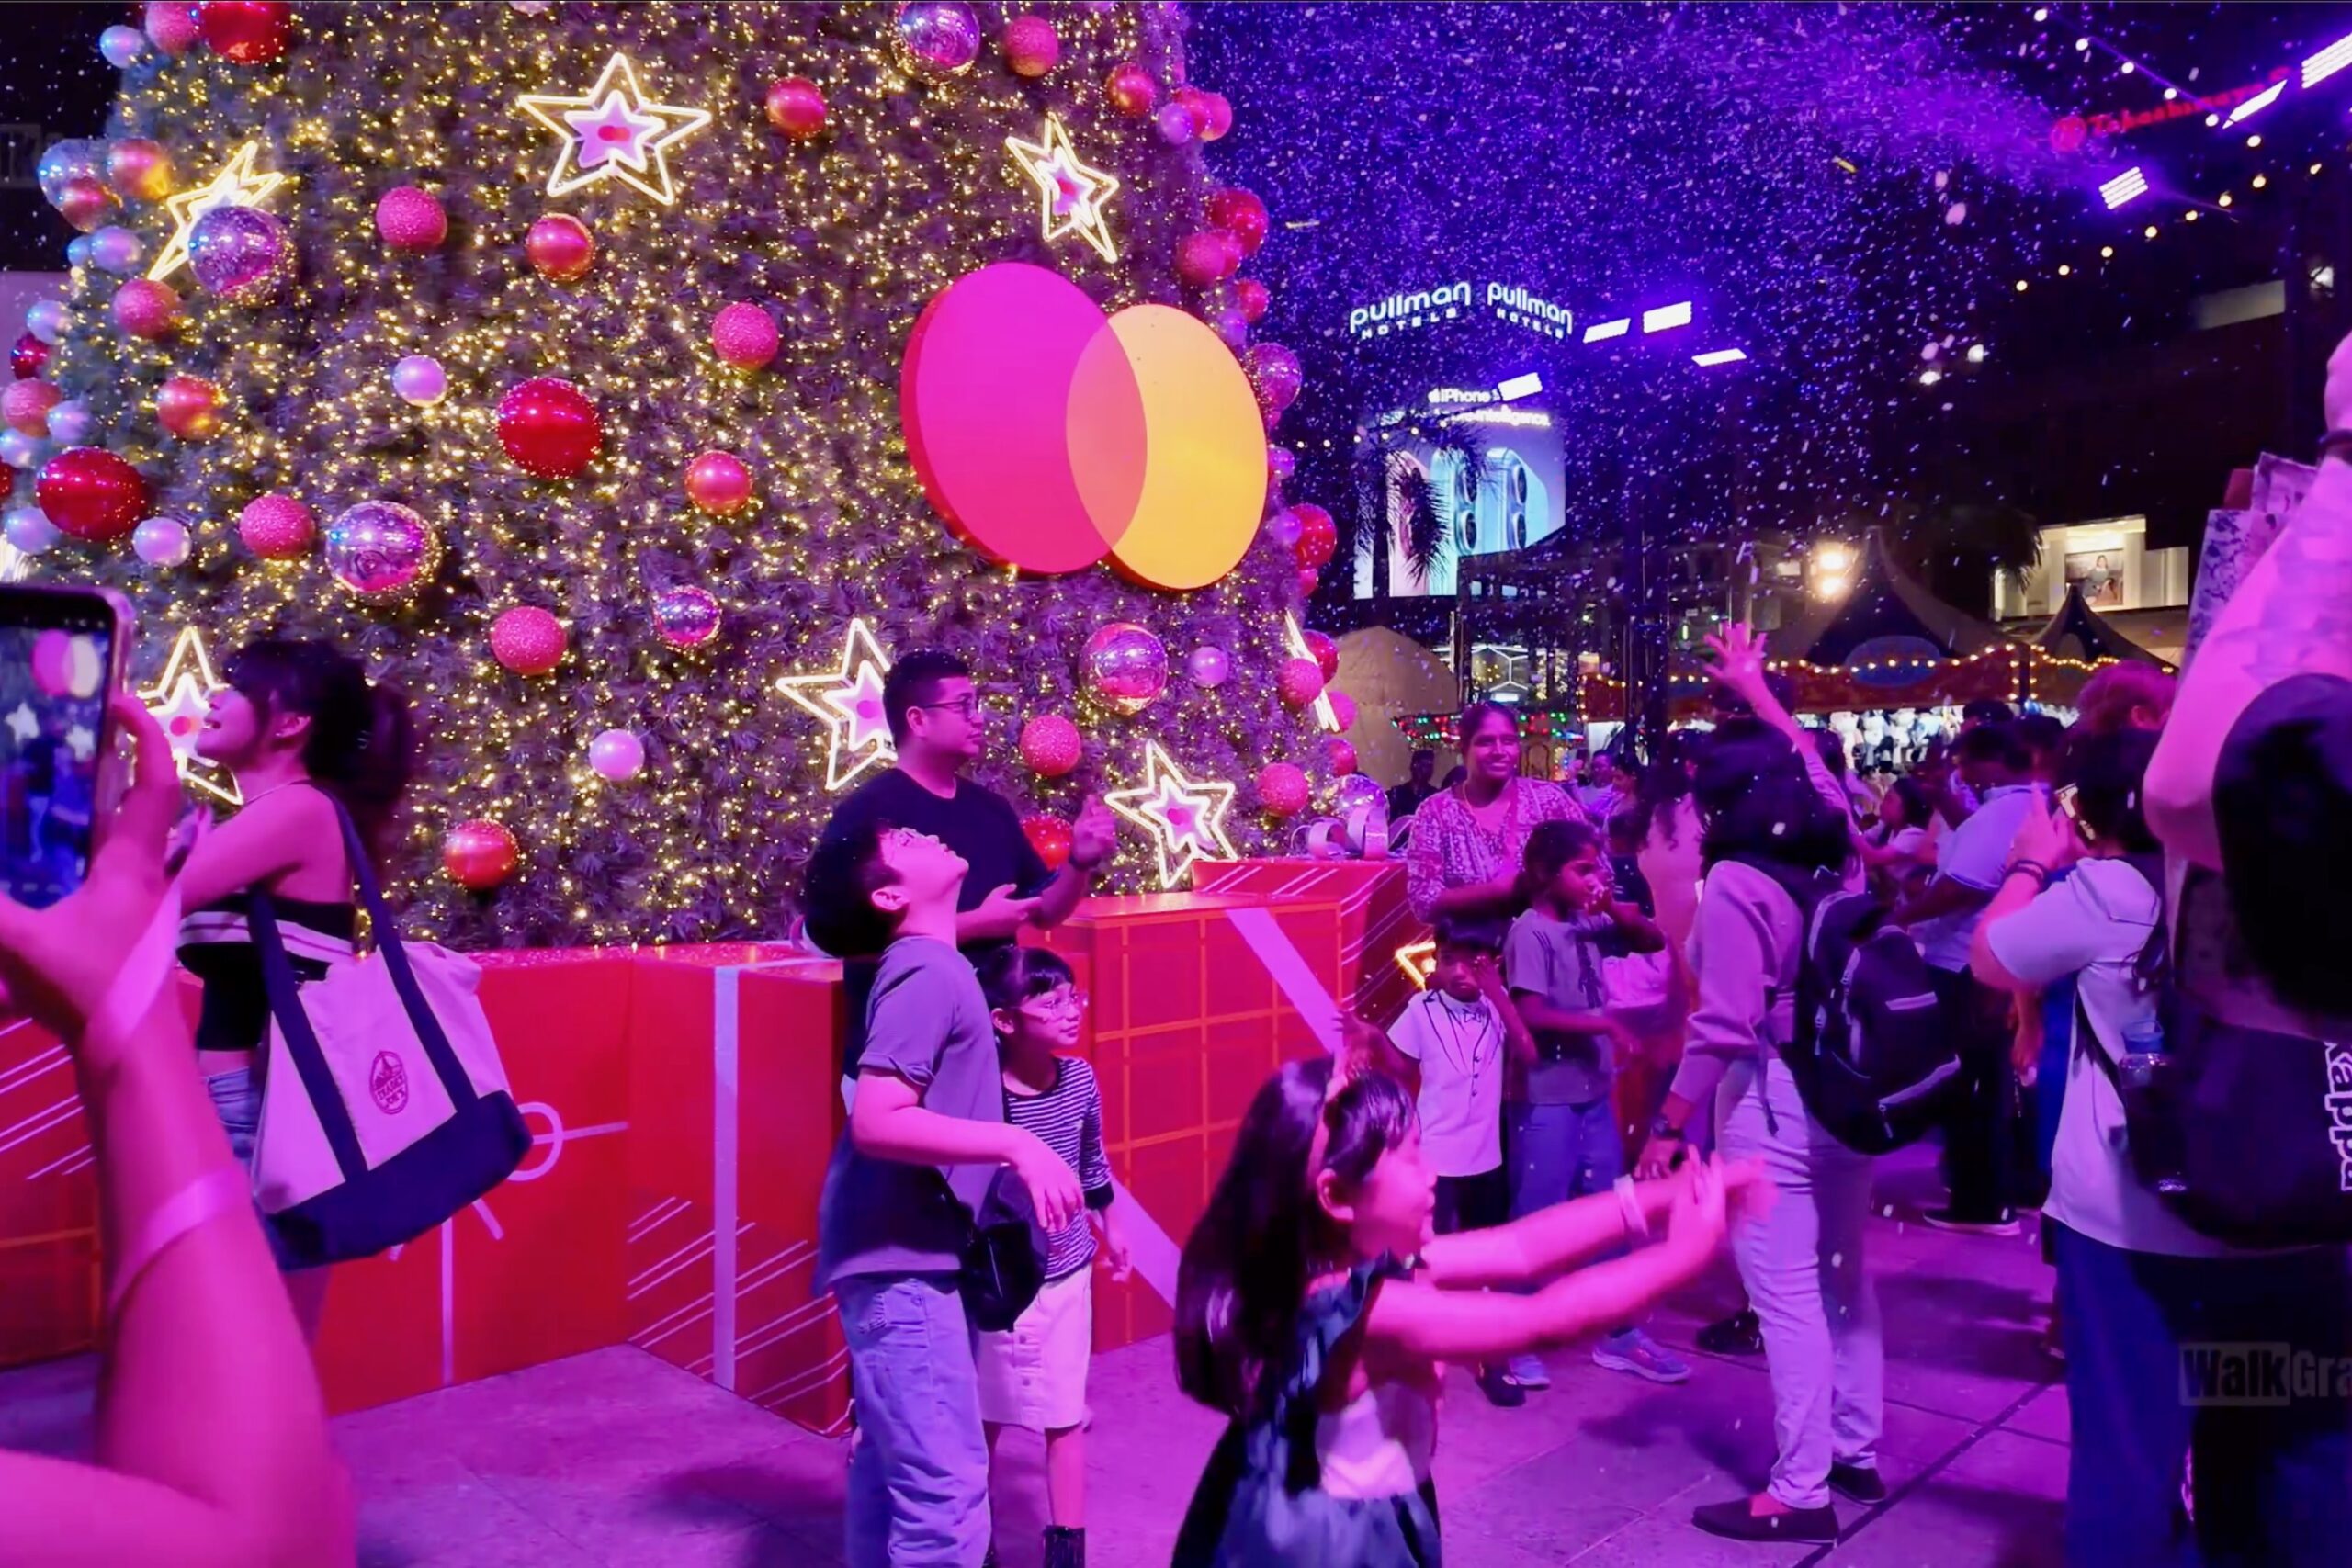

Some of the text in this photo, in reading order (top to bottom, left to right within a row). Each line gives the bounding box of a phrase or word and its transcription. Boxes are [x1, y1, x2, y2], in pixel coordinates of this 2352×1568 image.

[1350, 282, 1471, 334] pullman
[1361, 307, 1457, 340] HOTELS
[1487, 282, 1572, 334] pullman
[1497, 307, 1564, 340] HOTELS
[1440, 388, 1491, 403] iPhone
